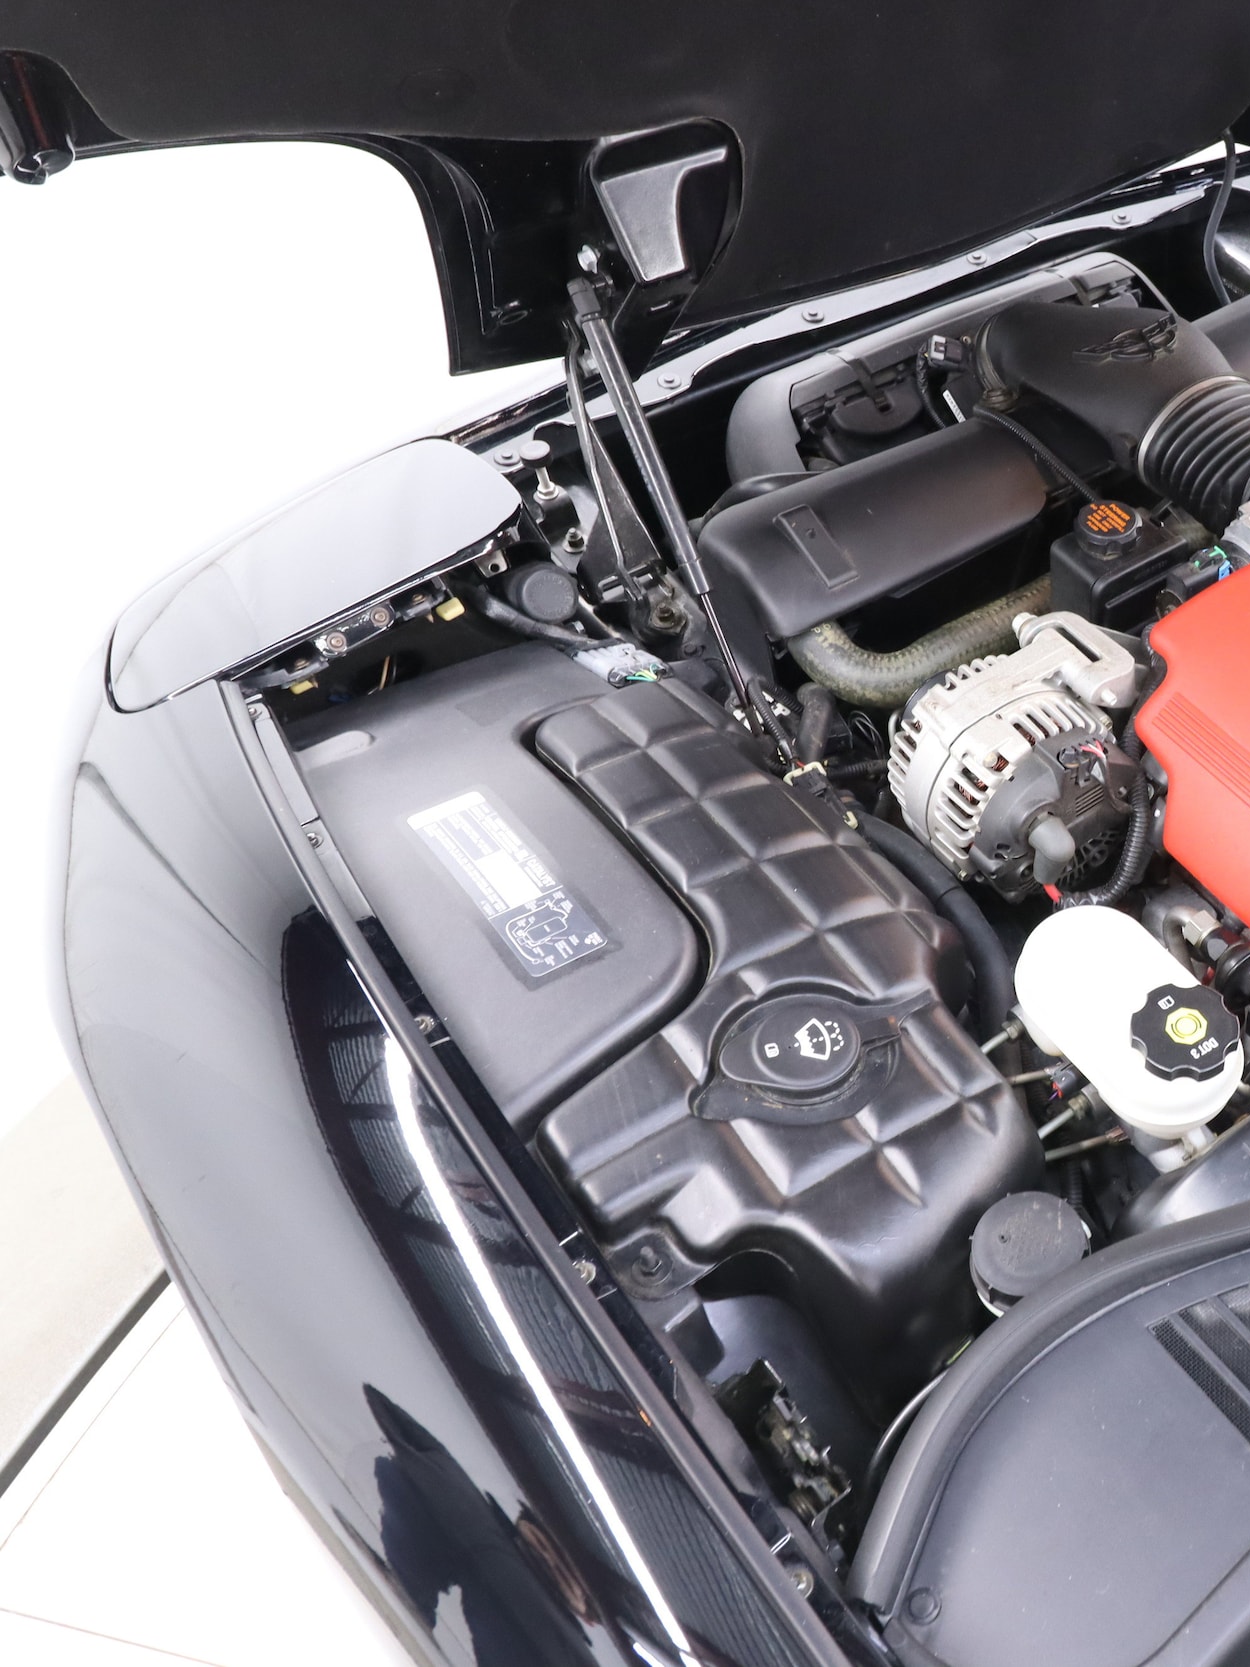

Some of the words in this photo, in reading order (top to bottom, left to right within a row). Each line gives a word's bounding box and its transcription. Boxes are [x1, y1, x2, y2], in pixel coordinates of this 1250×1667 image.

[1109, 503, 1131, 521] POWER
[1190, 1047, 1201, 1060] 3
[1198, 1036, 1219, 1056] DOT
